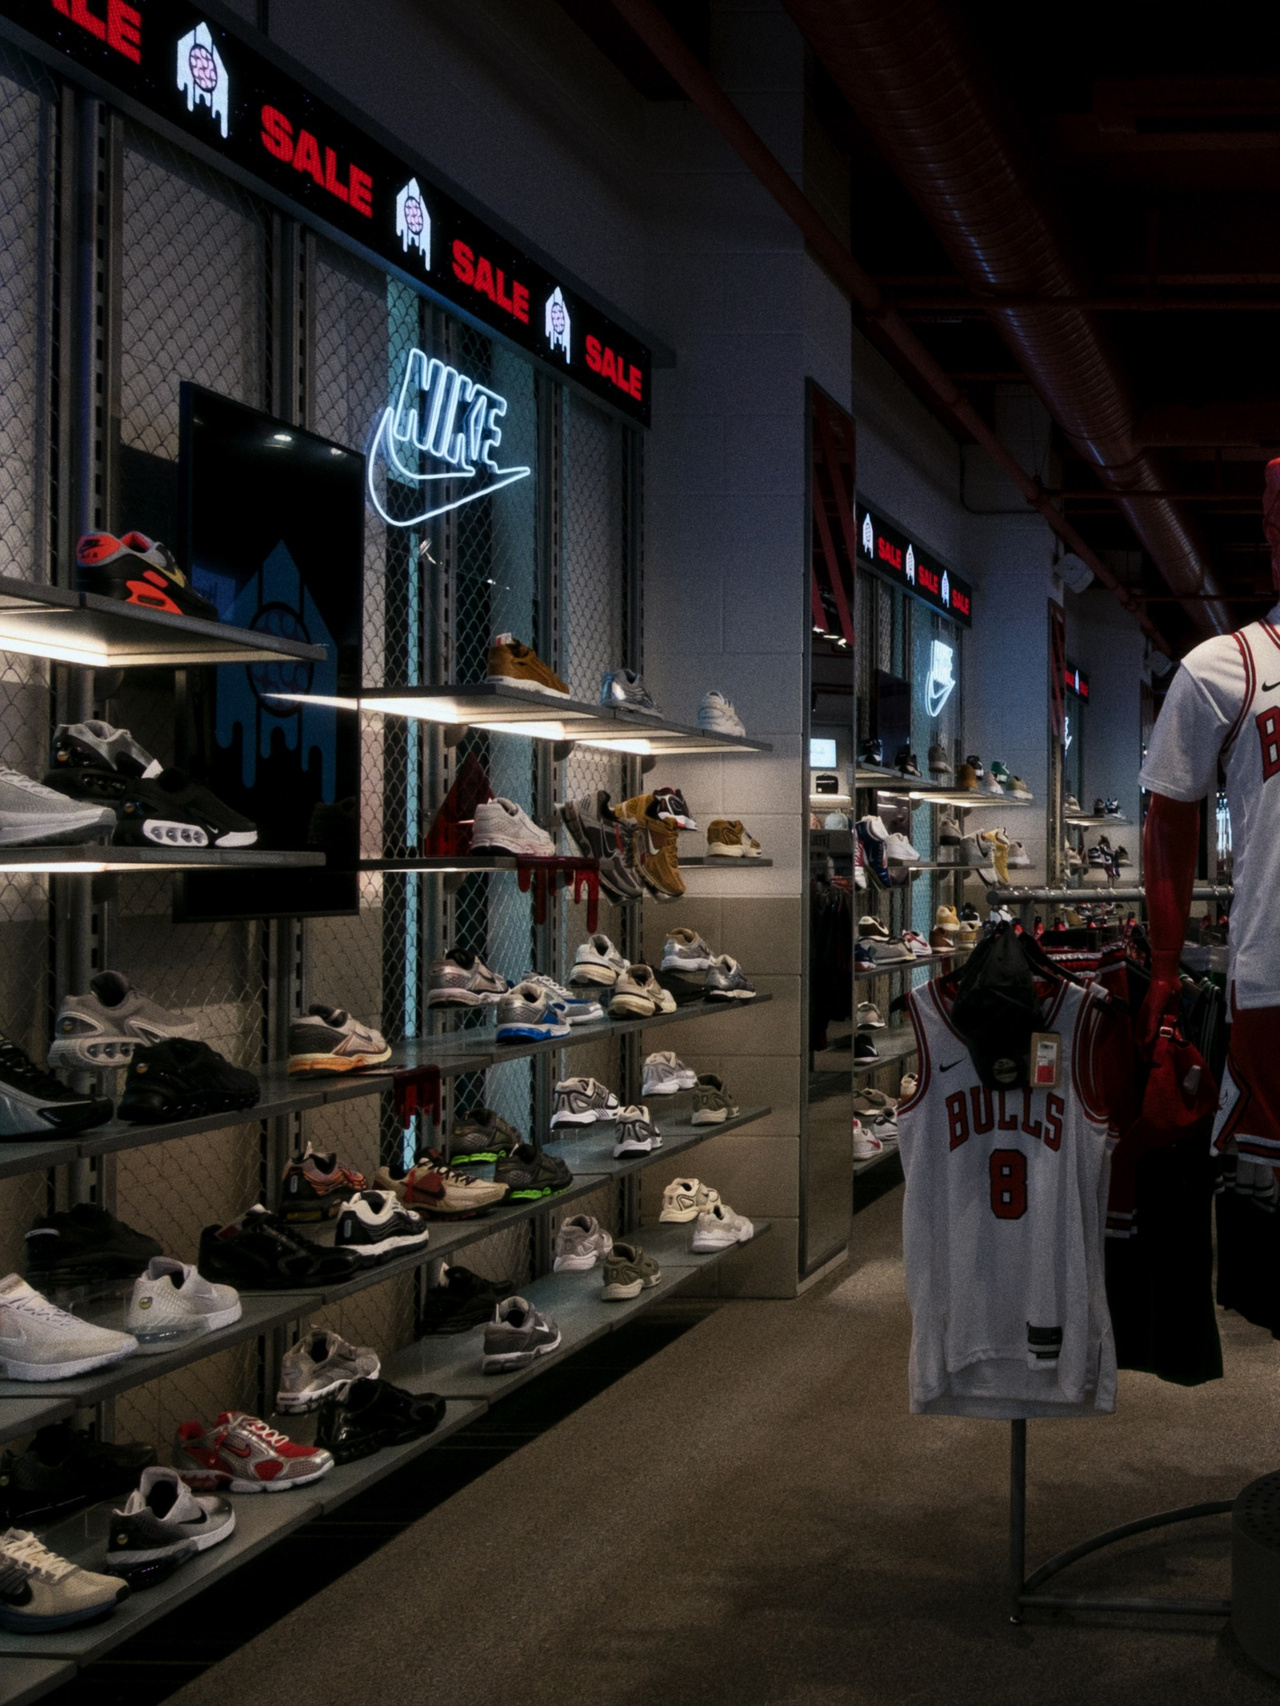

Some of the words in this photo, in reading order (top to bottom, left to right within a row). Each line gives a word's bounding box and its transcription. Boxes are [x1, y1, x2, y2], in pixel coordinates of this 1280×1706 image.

[53, 0, 141, 64] LE
[260, 104, 373, 219] SALE
[451, 238, 530, 325] SALE
[585, 334, 642, 401] SALE
[393, 347, 508, 474] NIKE
[877, 536, 903, 571] SALE
[917, 564, 940, 595] SALE
[952, 588, 970, 616] SALE
[945, 1086, 1065, 1152] BULLS
[989, 1149, 1028, 1219] 8
